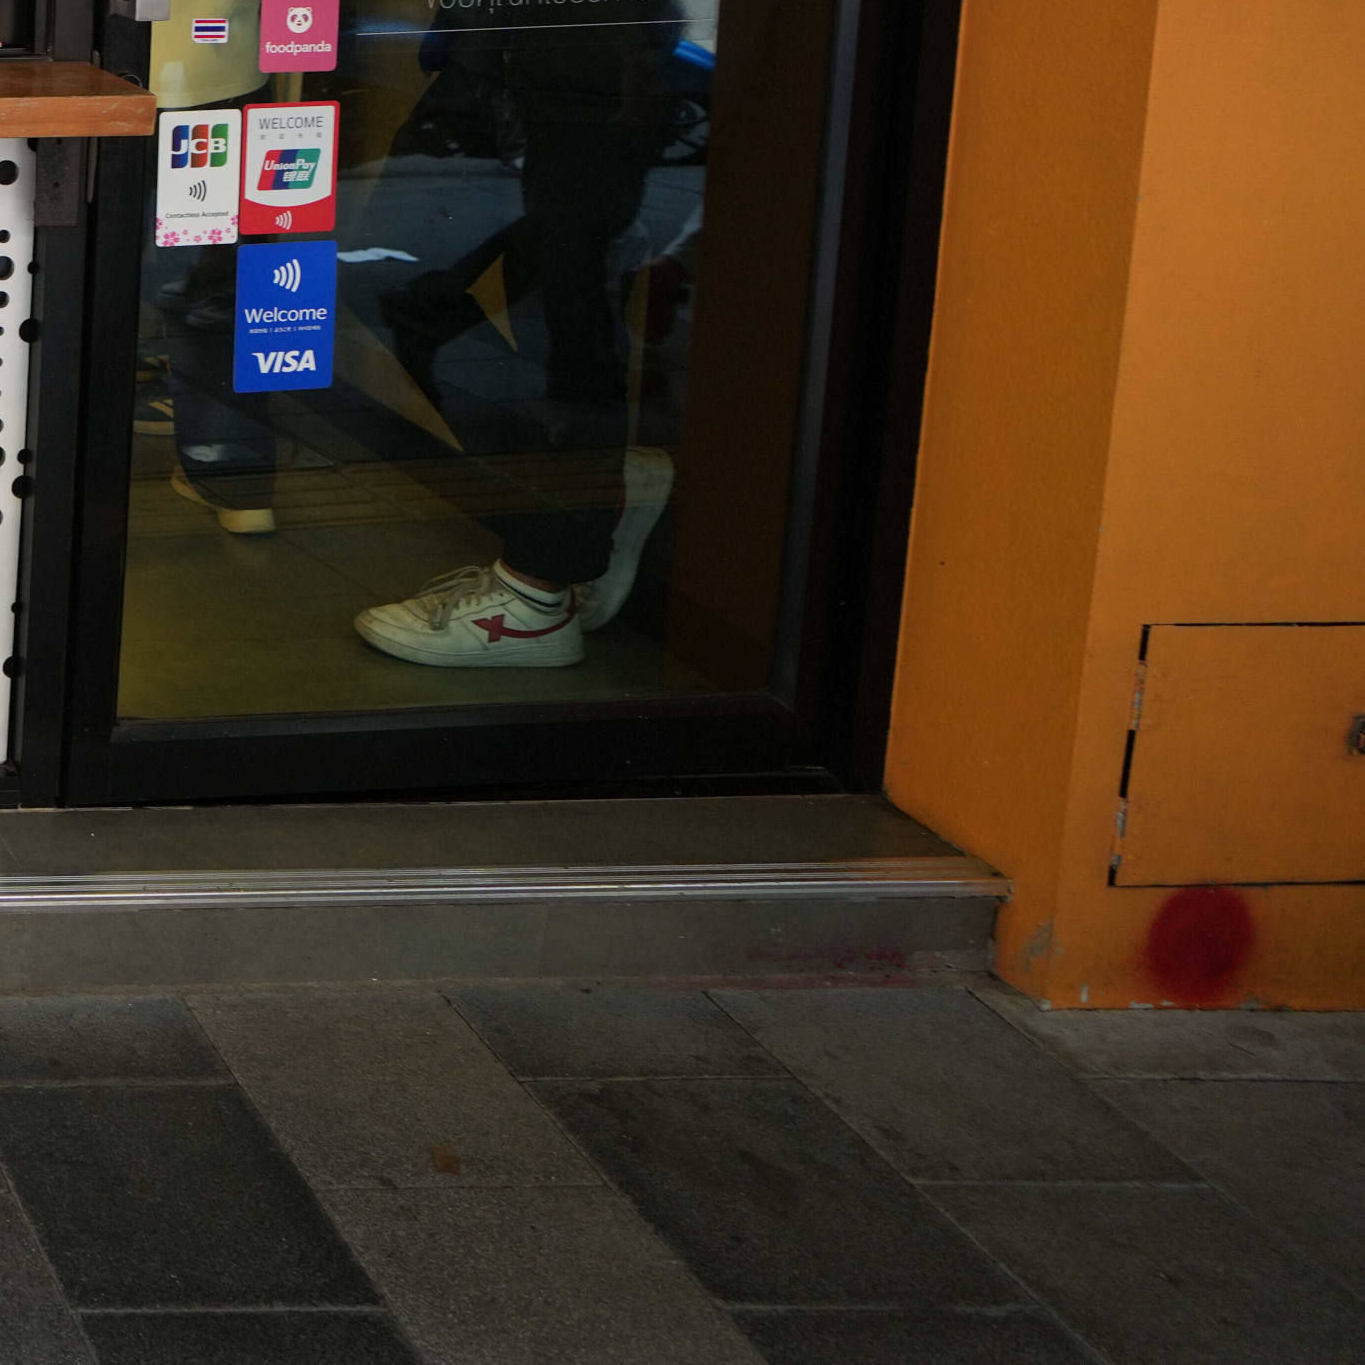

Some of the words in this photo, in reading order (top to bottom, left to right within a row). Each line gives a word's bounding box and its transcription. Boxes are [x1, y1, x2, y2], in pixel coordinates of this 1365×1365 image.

[265, 40, 332, 56] foodpanda
[258, 116, 324, 130] WELCOME
[170, 137, 228, 155] JCB
[264, 159, 318, 173] UnionPay
[244, 307, 328, 324] Welcome
[251, 349, 317, 374] VISA
